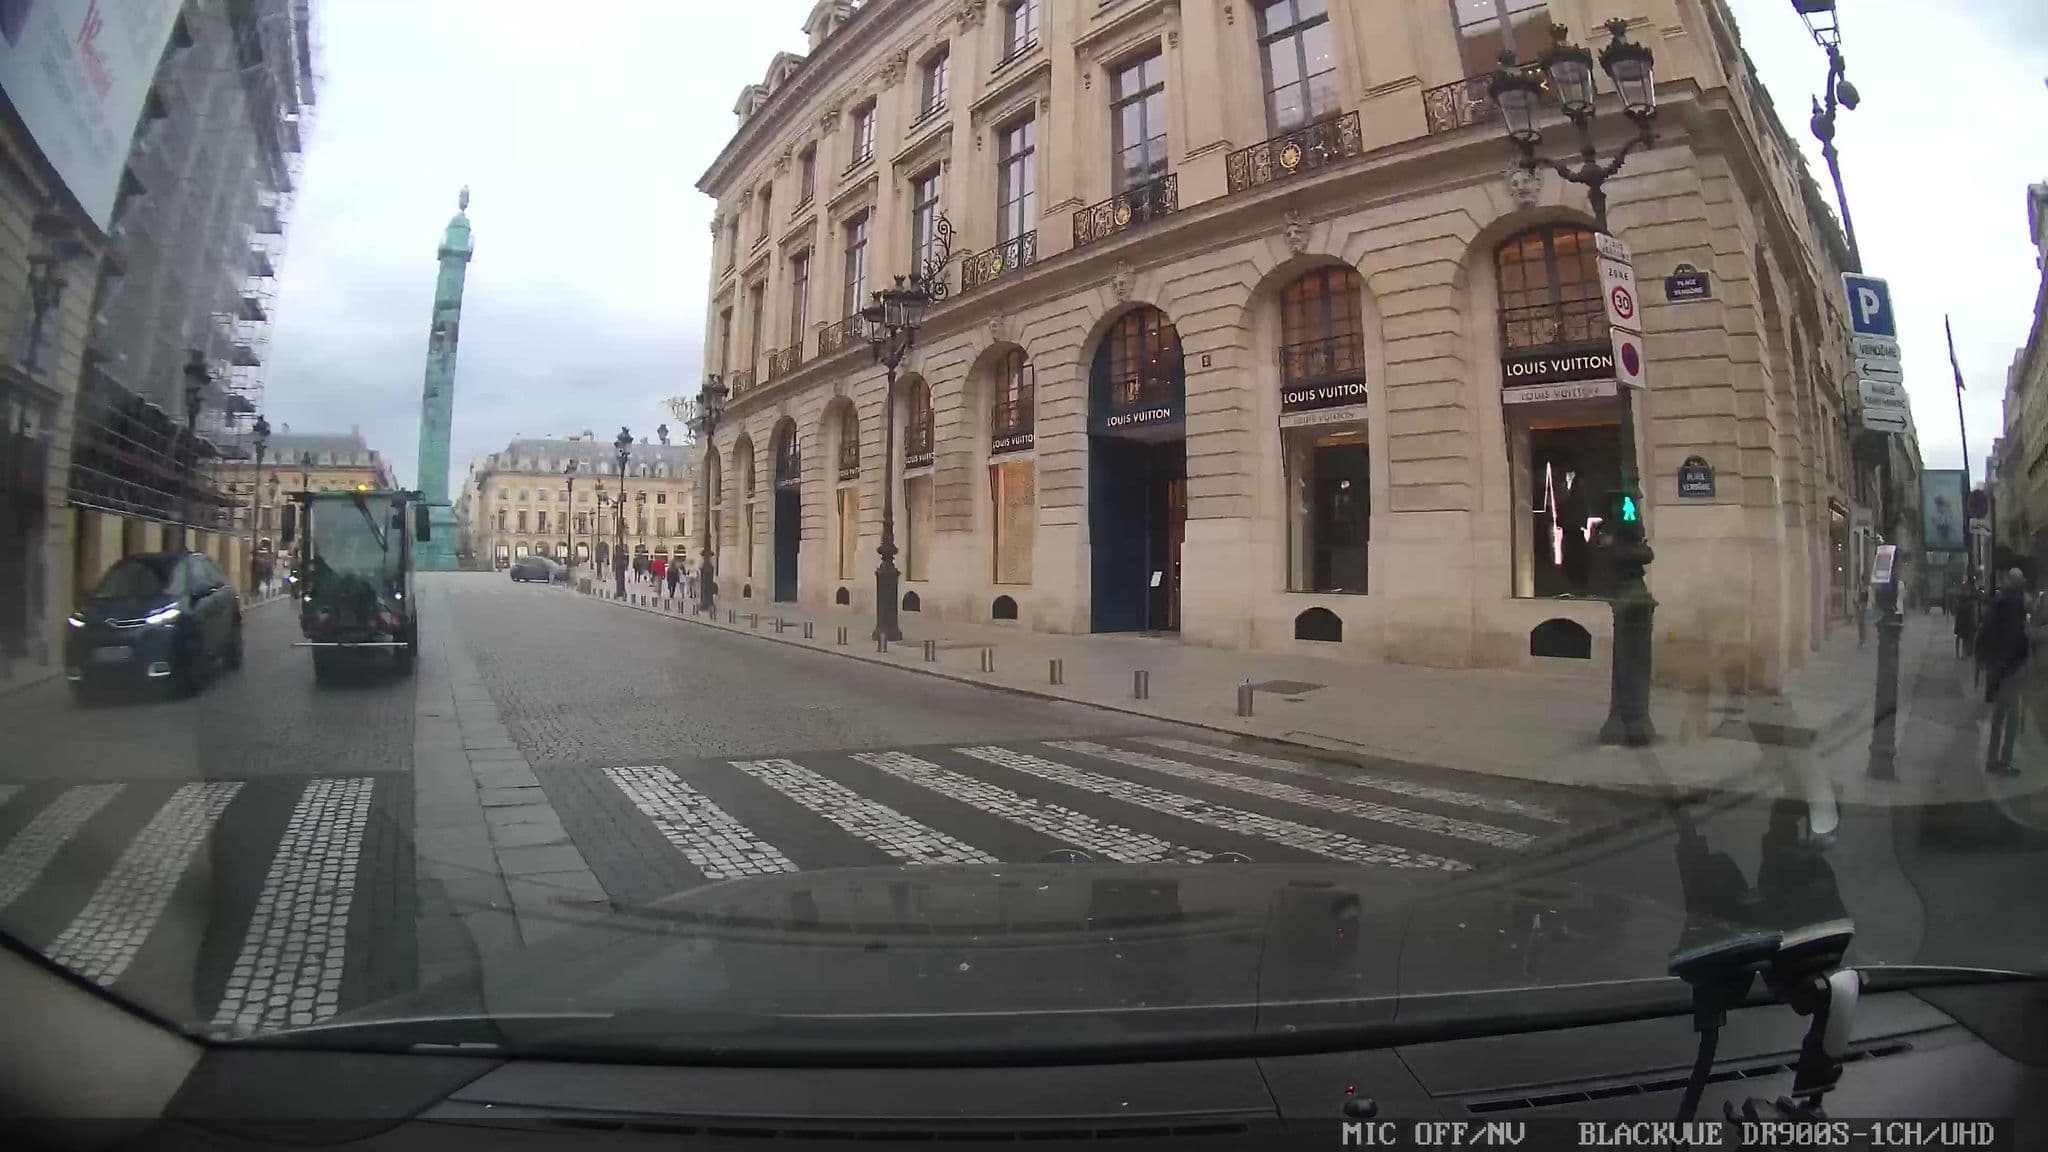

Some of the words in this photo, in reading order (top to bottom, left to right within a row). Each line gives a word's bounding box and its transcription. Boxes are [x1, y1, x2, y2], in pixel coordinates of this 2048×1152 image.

[1608, 268, 1629, 281] ZONE
[1615, 295, 1630, 311] 30
[1858, 287, 1880, 324] P
[1507, 361, 1547, 376] LOUIS
[1551, 355, 1613, 372] VUITTON
[1284, 390, 1315, 404] LOUIS
[1319, 383, 1368, 399] VUITTON
[1107, 414, 1131, 427] LOUIS
[1133, 408, 1170, 422] VUITTON
[992, 438, 1010, 449] LOUIS
